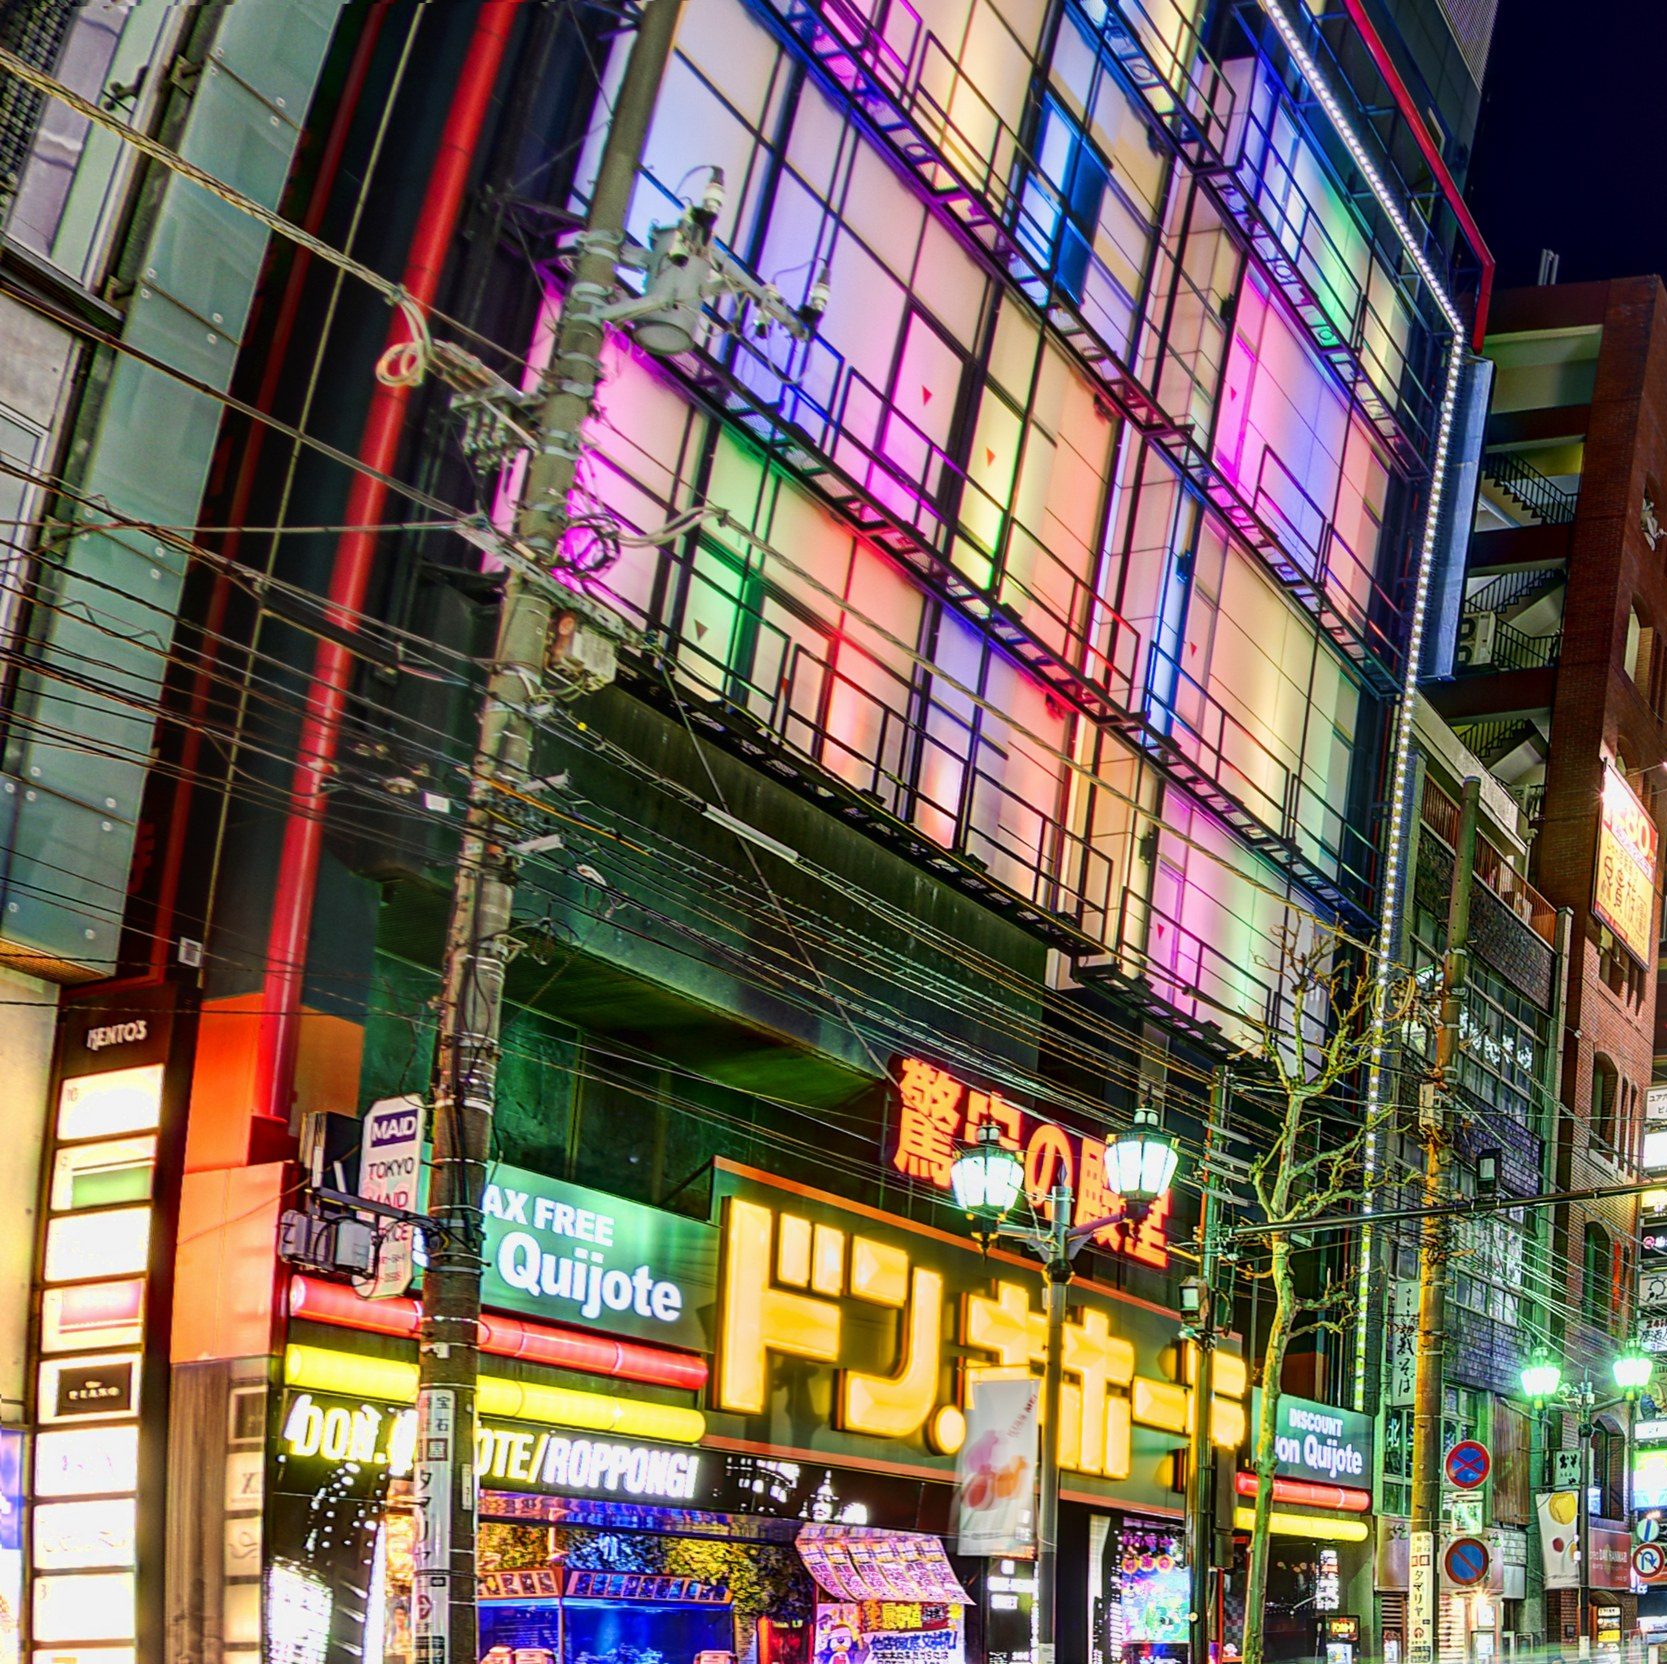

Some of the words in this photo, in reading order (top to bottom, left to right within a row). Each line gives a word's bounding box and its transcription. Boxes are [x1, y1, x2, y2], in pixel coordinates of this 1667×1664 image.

[372, 1116, 417, 1142] MAID
[368, 1157, 414, 1181] TOKYO
[483, 1184, 528, 1217] AX
[533, 1197, 614, 1249] FREE
[499, 1231, 682, 1322] Quijote
[1288, 1408, 1344, 1437] DISCOUNT
[1303, 1434, 1363, 1478] Quijote
[1413, 1569, 1424, 1617] タマリヤ
